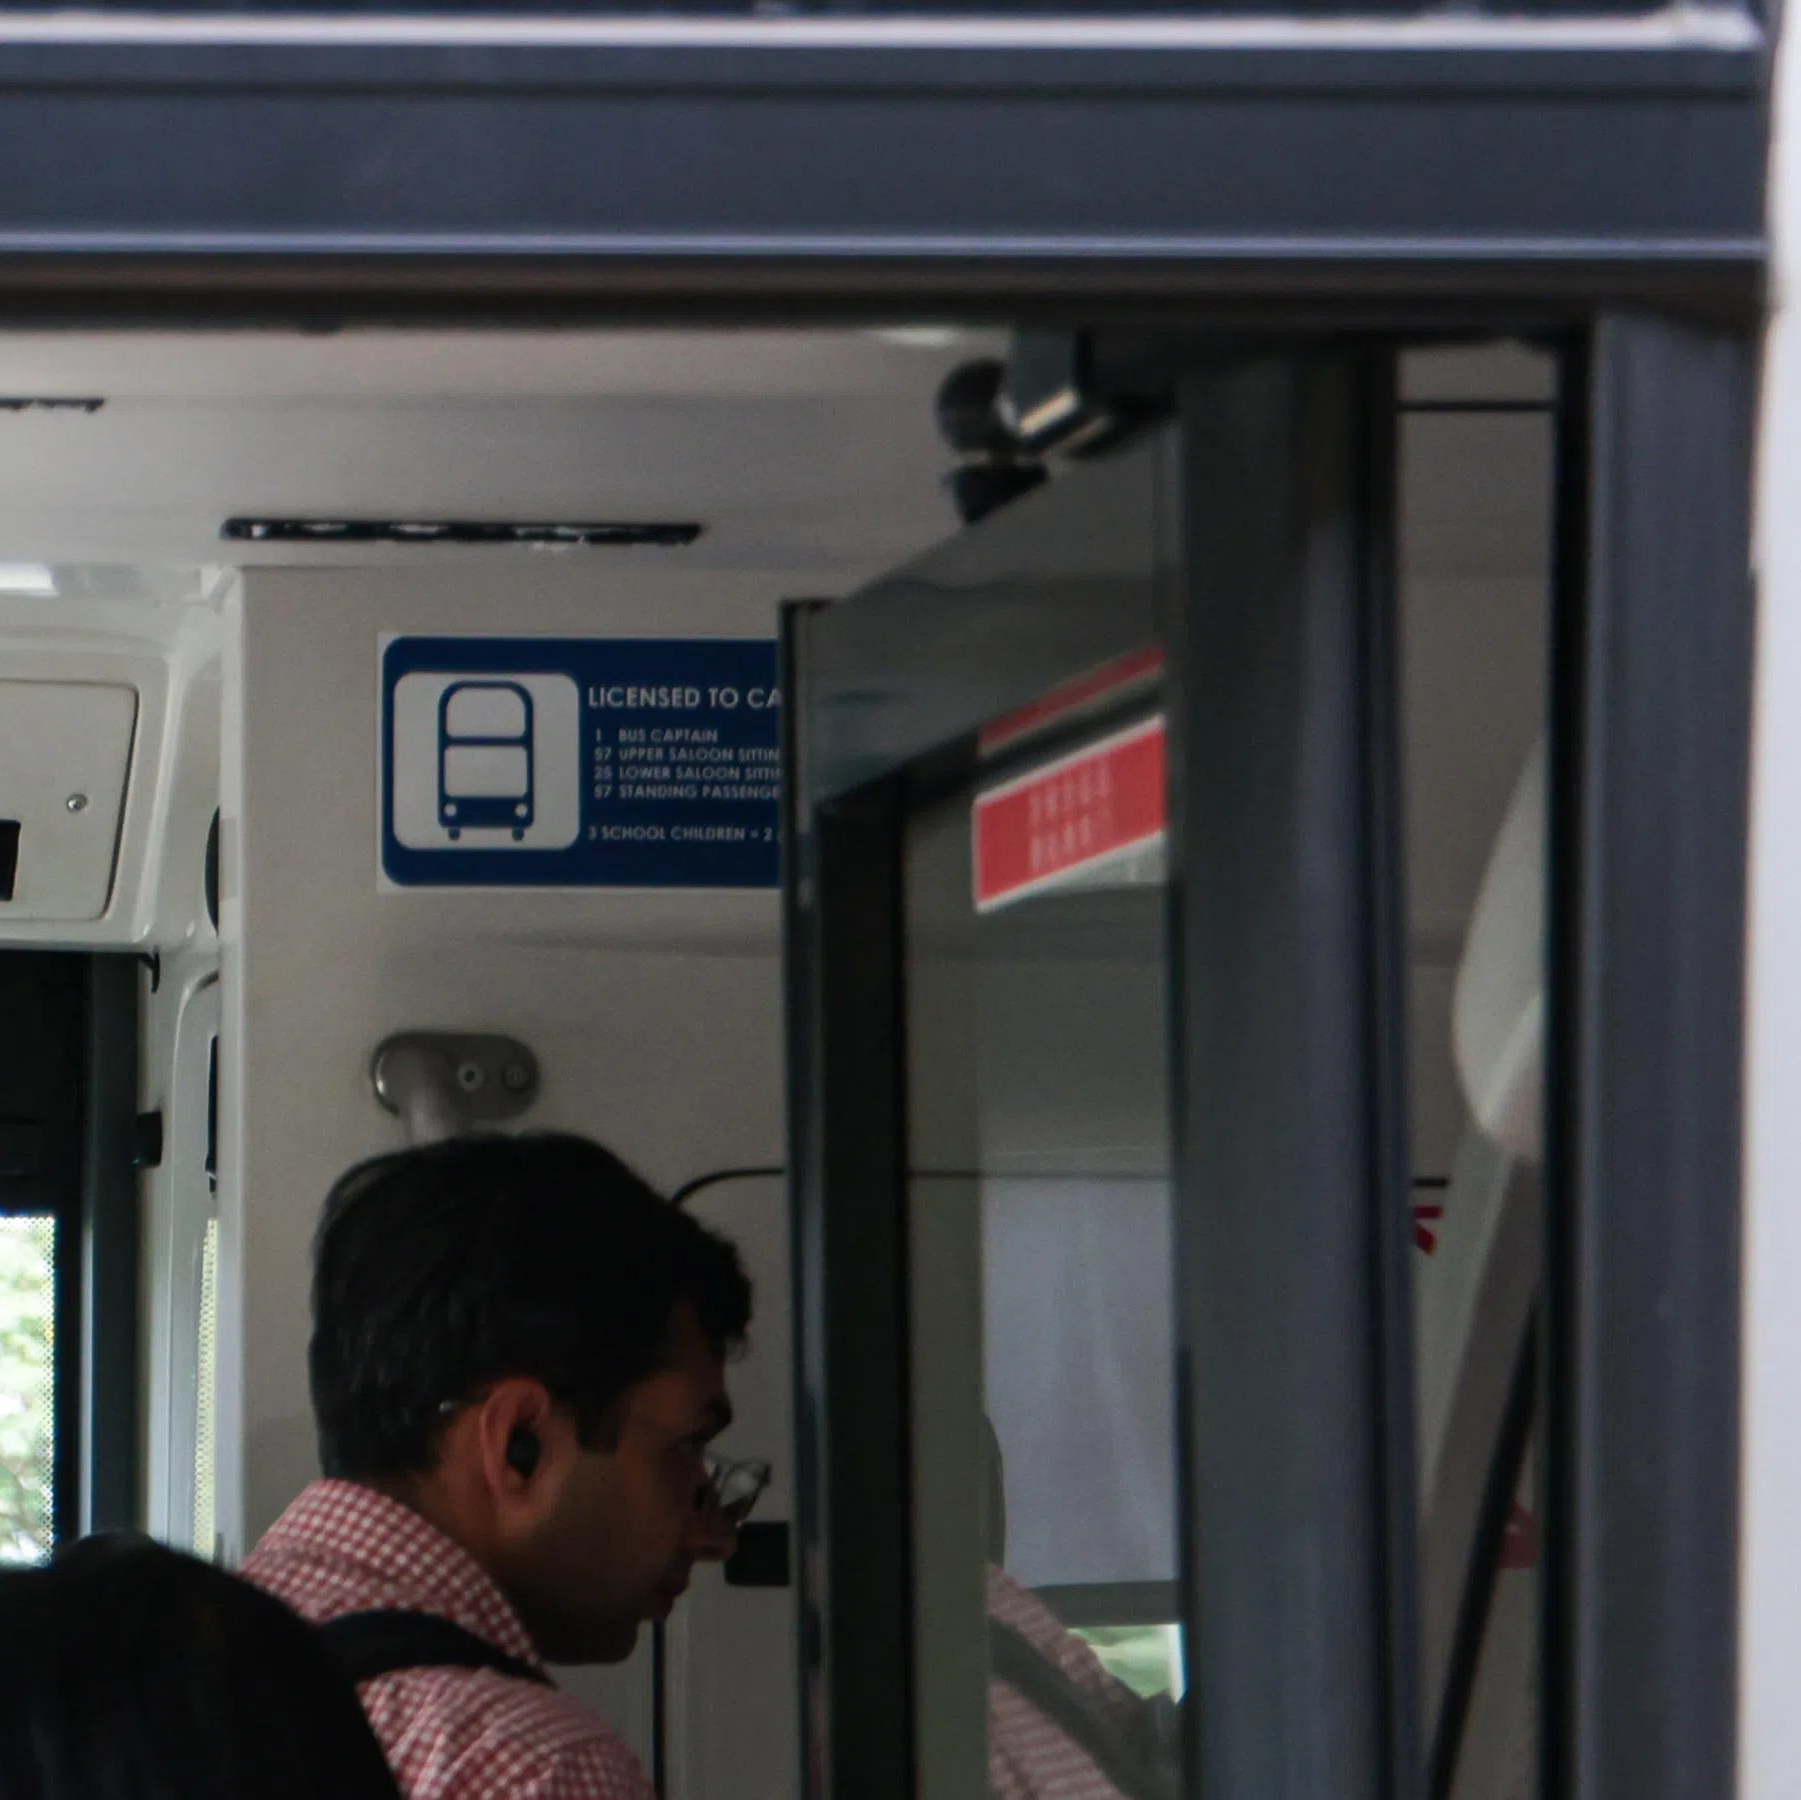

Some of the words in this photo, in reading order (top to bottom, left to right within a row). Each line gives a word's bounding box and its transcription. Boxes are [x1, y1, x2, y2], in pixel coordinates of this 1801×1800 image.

[588, 687, 700, 708] LICENSED
[708, 688, 739, 709] TO
[747, 688, 783, 709] CA
[618, 728, 646, 742] BUS
[650, 728, 719, 743] CAPTAIN
[618, 748, 663, 761] UPPER
[669, 748, 733, 761] SALOON
[738, 748, 781, 762] SITTIN
[618, 766, 671, 780] LOWER
[675, 766, 740, 780] SALOON
[618, 784, 697, 798] STANDING
[702, 784, 783, 798] PASSENGE
[602, 826, 667, 840] SCHOOL
[670, 826, 745, 840] CHILDREN
